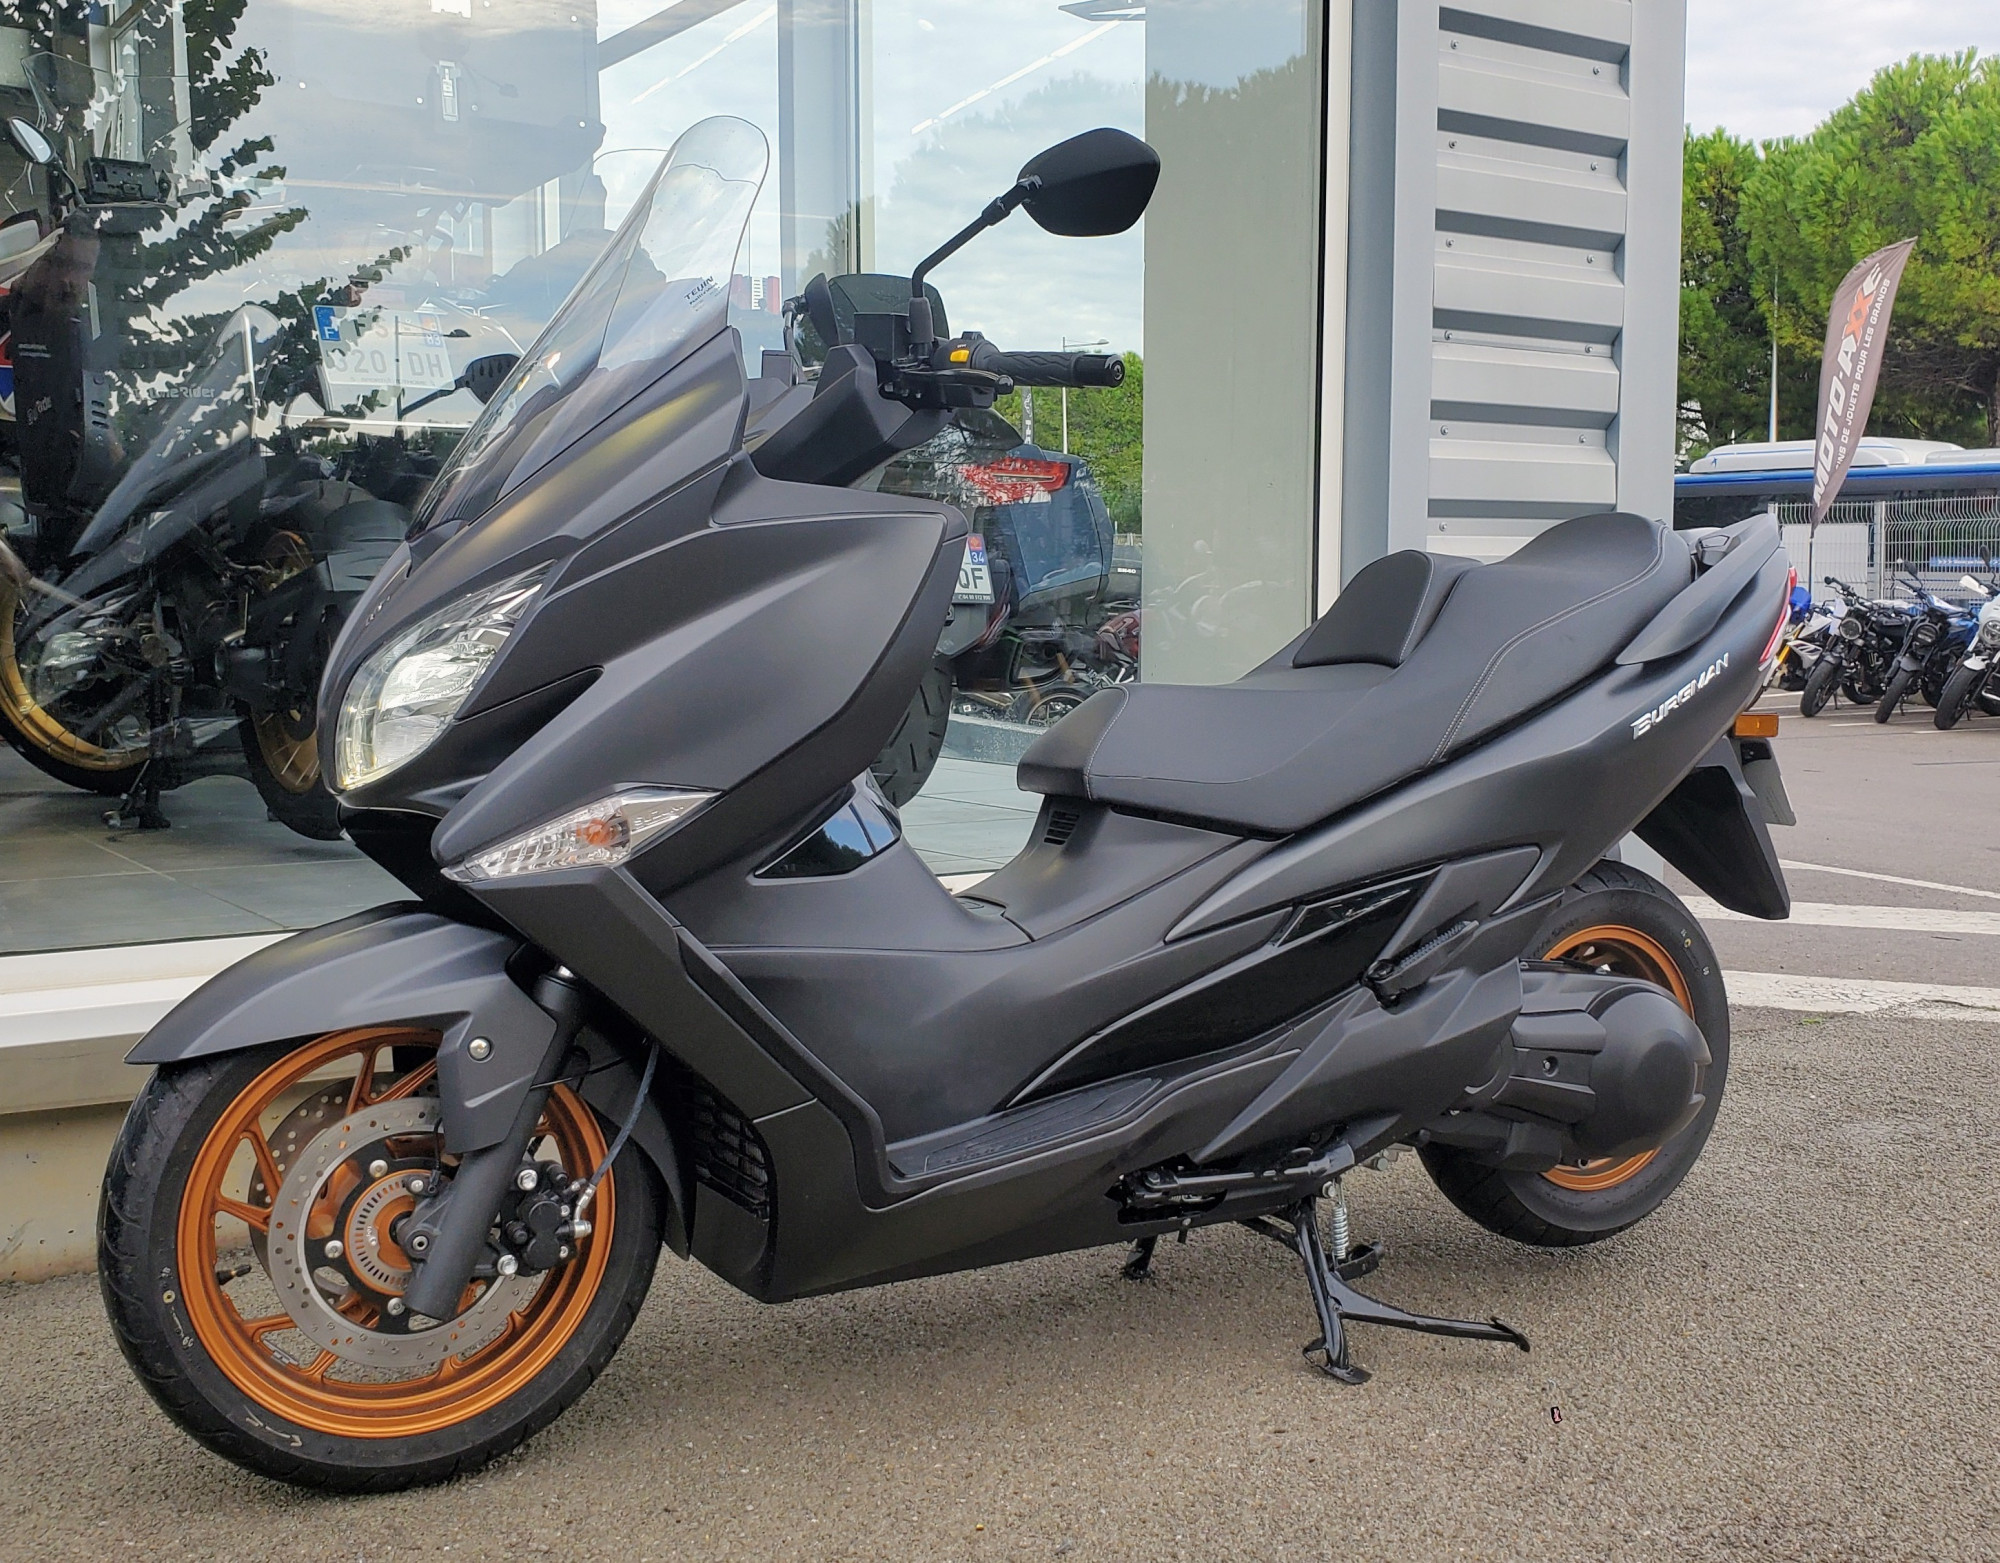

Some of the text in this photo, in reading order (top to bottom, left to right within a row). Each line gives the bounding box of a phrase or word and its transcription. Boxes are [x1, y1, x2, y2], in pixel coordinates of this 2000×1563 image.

[1869, 278, 1891, 325] GRANDS
[324, 326, 335, 339] F
[426, 334, 441, 345] 83
[1864, 327, 1875, 348] LES
[408, 351, 444, 378] DH
[1854, 351, 1868, 381] POUR
[1813, 262, 1882, 507] MOTO-AXXE
[1847, 382, 1861, 426] JOUETS
[1841, 427, 1851, 444] DE
[972, 552, 984, 563] 34
[959, 567, 983, 589] QF
[1630, 652, 1729, 740] BURGMAN
